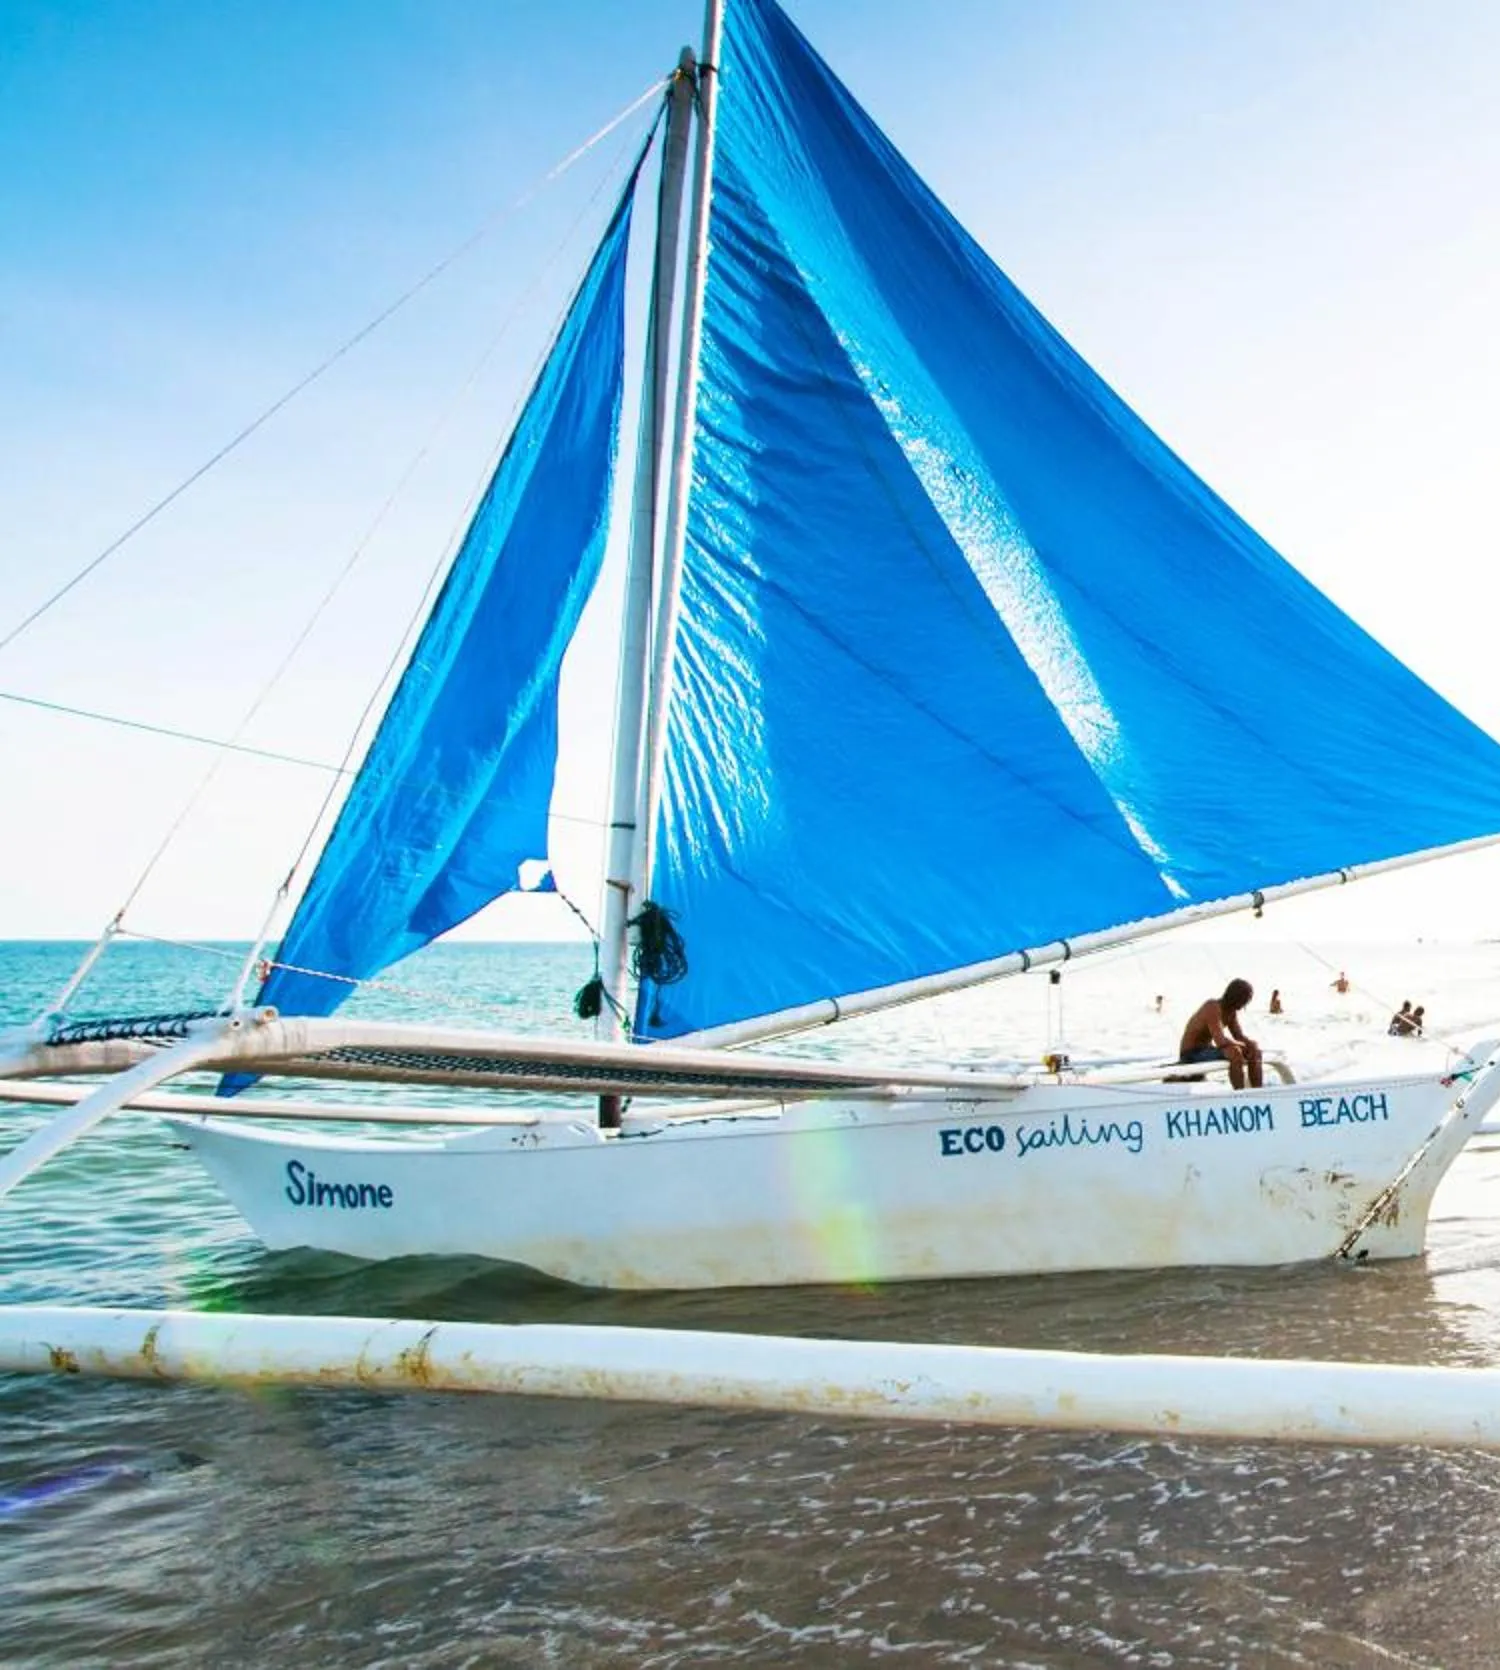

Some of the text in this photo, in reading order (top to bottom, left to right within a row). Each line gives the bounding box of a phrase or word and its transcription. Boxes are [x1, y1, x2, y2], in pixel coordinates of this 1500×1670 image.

[939, 1093, 1389, 1158] ECO sailing KHANOM BEACH
[285, 1159, 394, 1209] Simone
